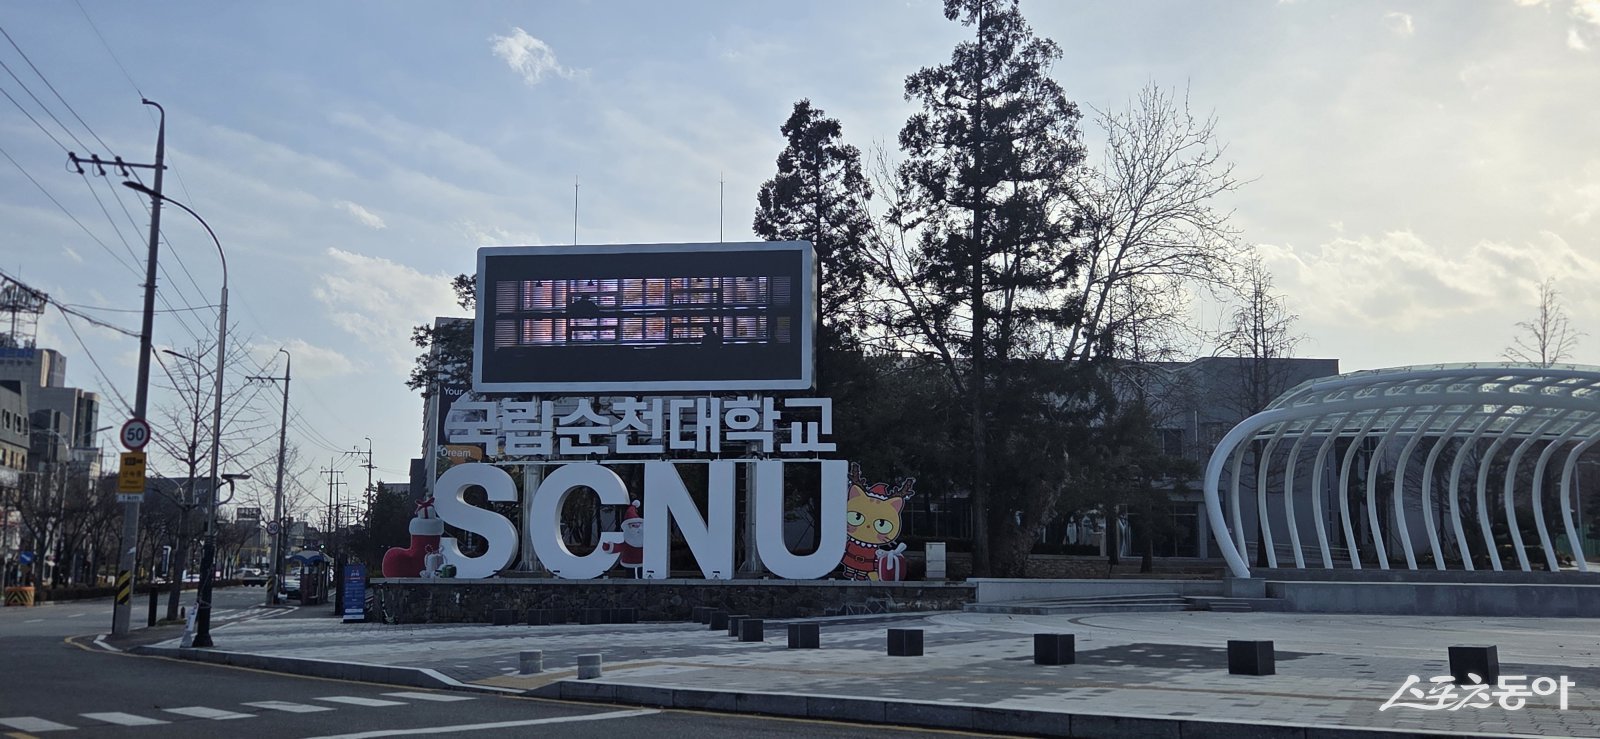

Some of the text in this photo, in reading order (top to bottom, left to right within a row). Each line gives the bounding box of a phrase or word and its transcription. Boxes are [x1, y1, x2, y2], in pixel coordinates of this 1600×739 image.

[444, 387, 463, 395] Your
[449, 397, 838, 456] 국립순천대학교
[127, 428, 144, 441] 50
[441, 448, 470, 457] Dream
[434, 459, 849, 580] SCNU
